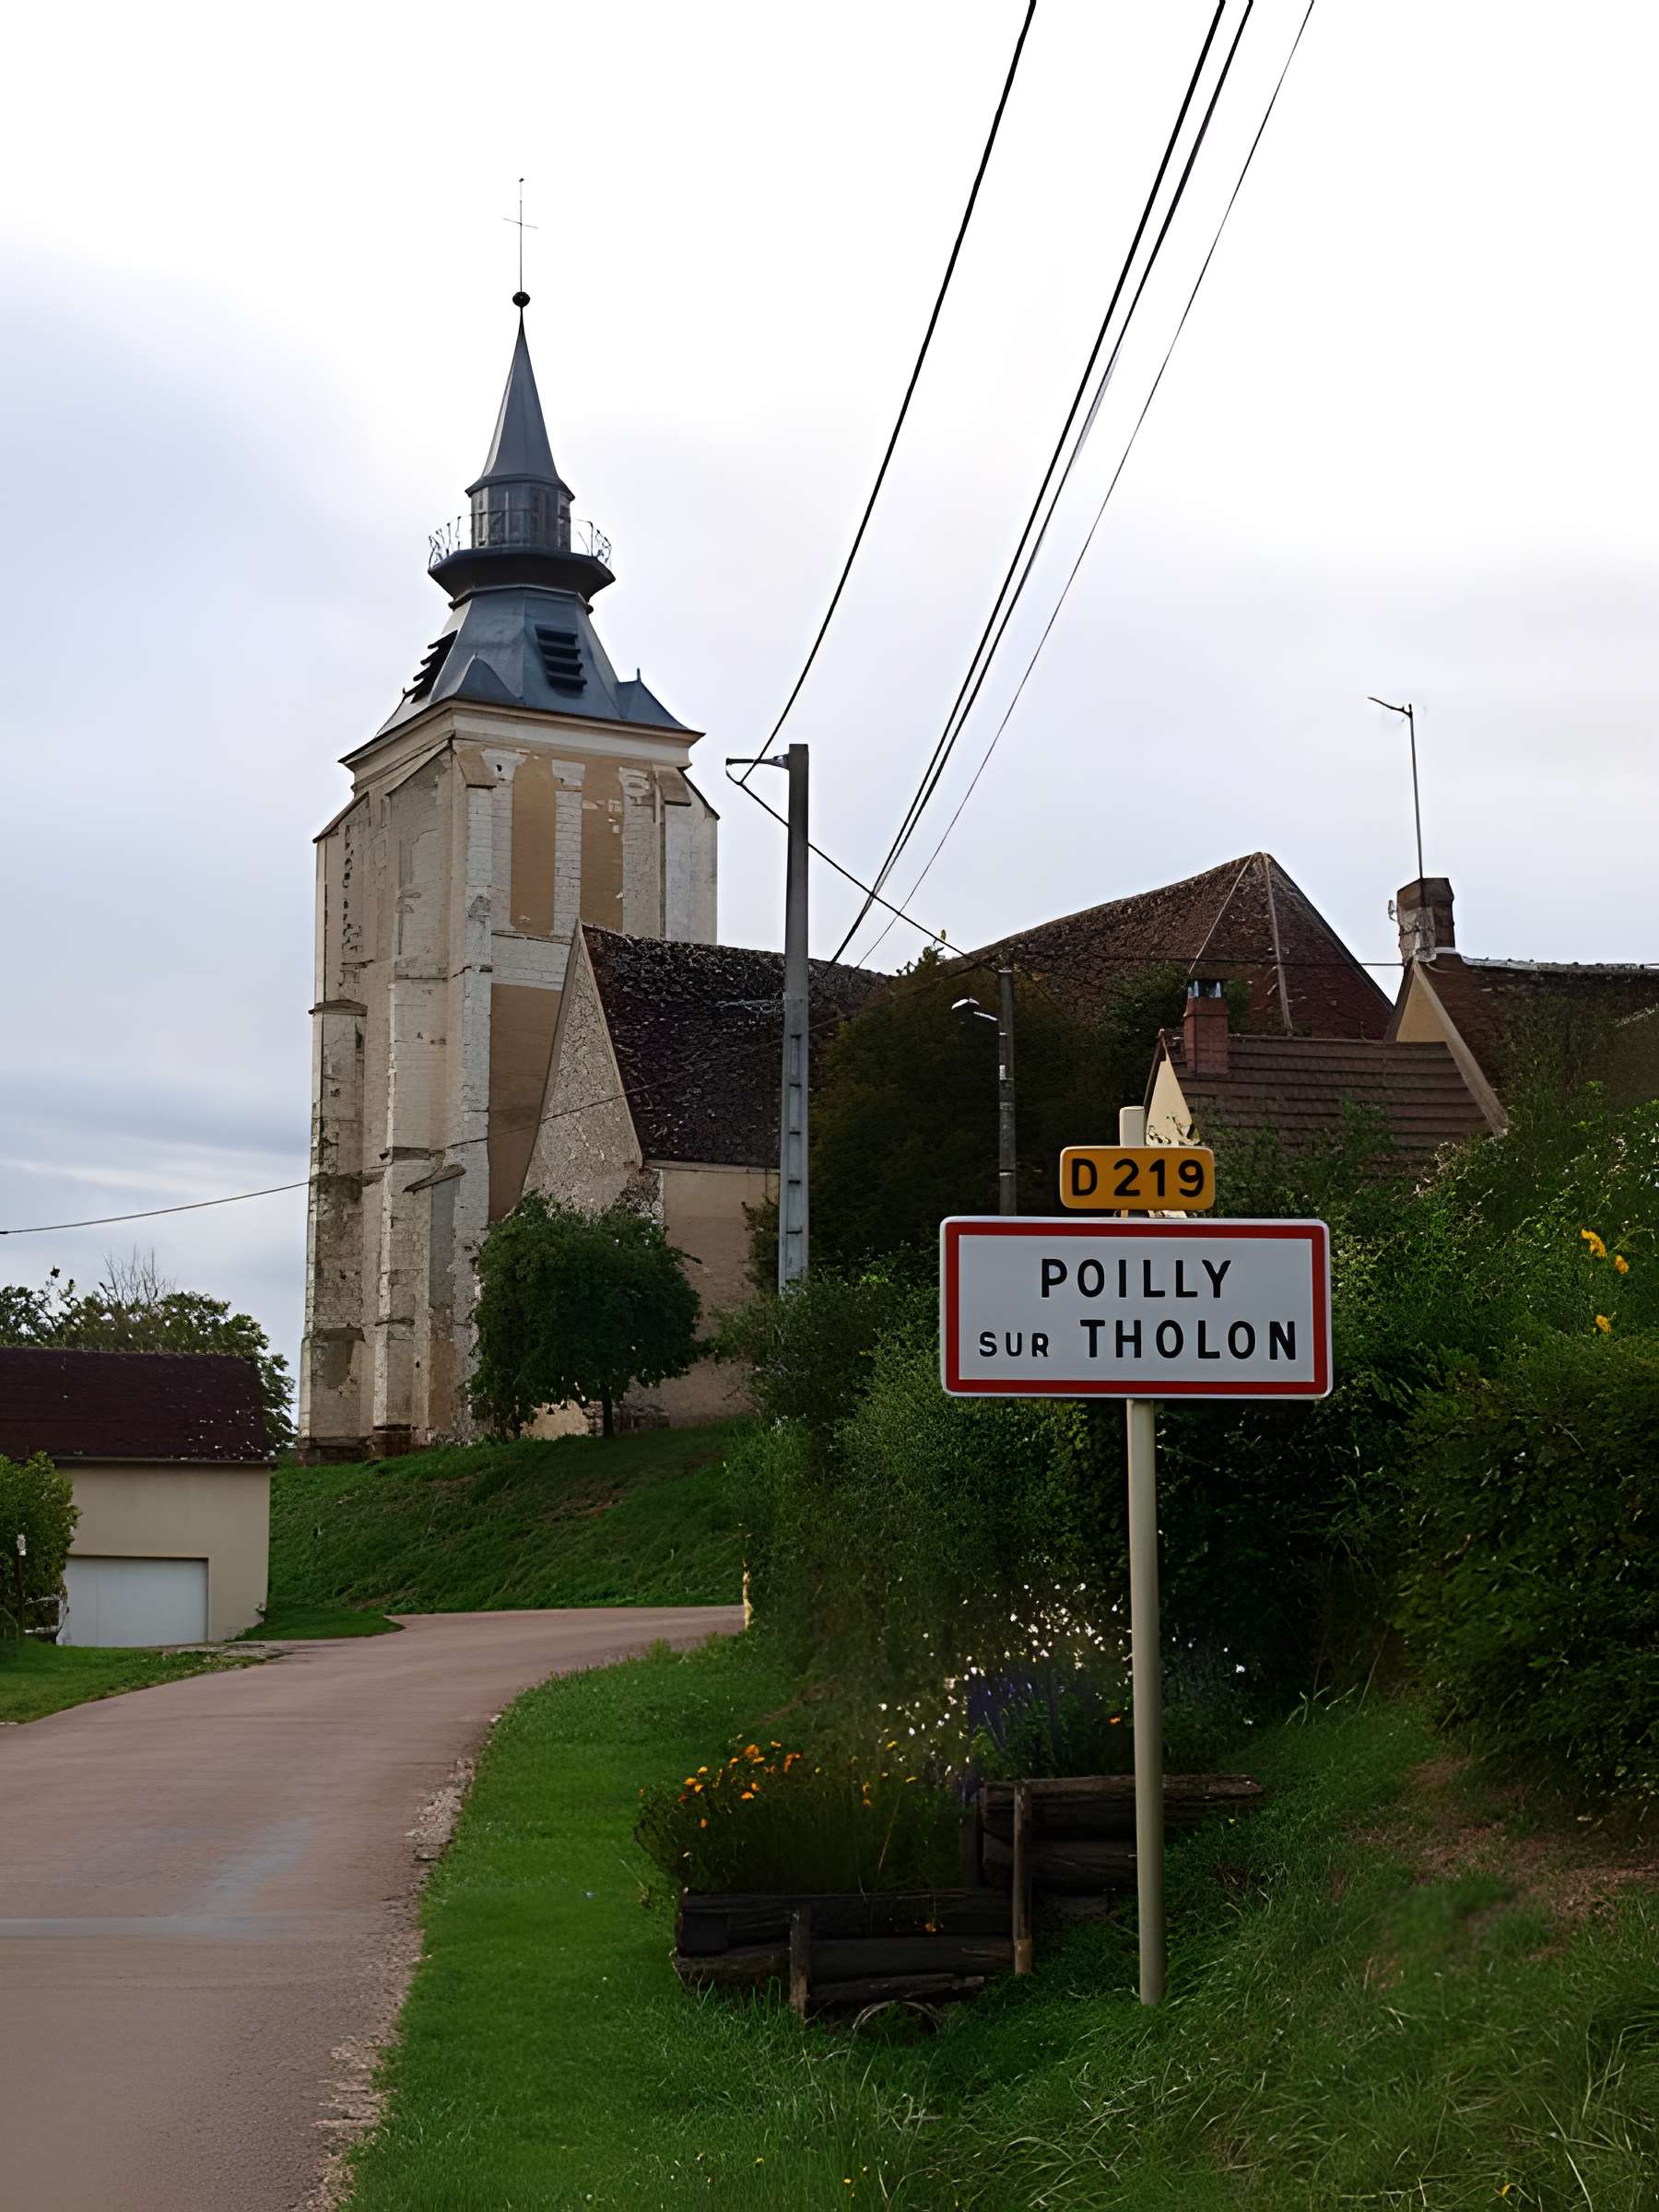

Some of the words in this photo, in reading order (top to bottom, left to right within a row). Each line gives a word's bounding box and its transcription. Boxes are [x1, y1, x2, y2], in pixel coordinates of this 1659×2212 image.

[1071, 1158, 1099, 1197] D
[1113, 1158, 1205, 1198] 219
[1041, 1258, 1231, 1299] POILLY
[979, 1331, 1050, 1358] SUR
[1079, 1319, 1297, 1360] THOLON
